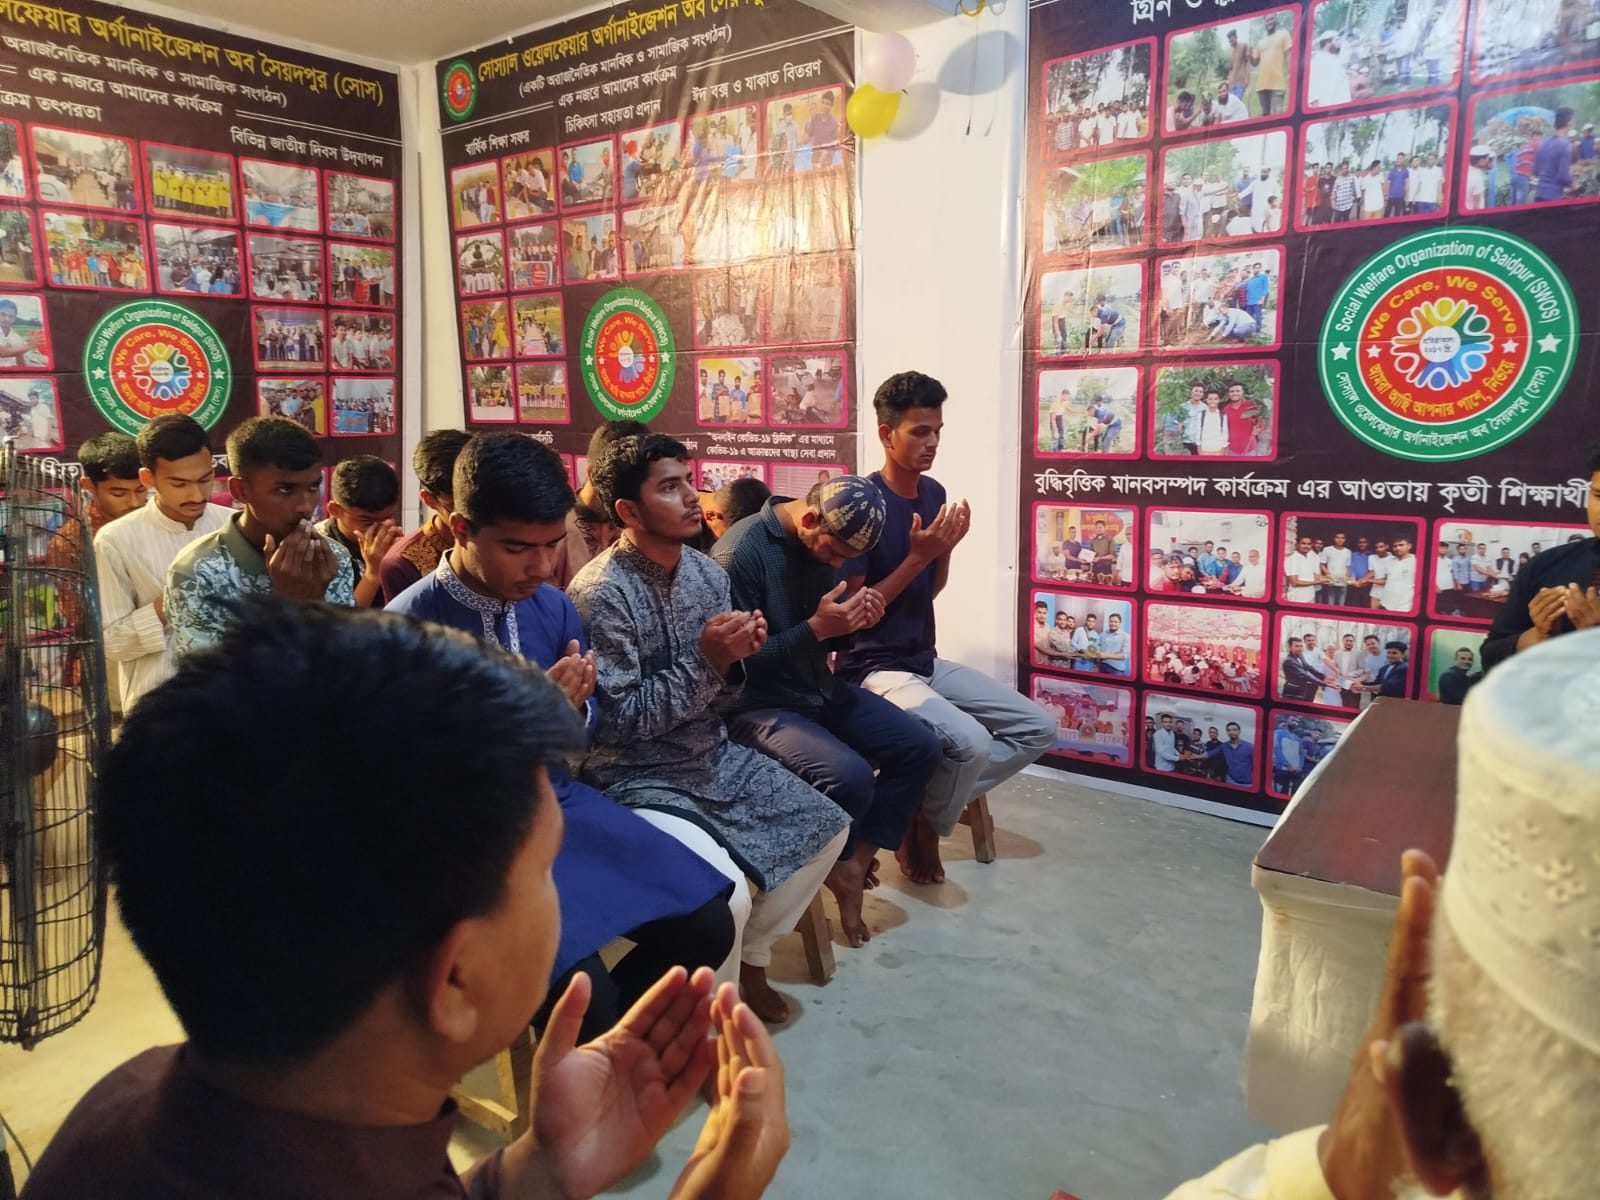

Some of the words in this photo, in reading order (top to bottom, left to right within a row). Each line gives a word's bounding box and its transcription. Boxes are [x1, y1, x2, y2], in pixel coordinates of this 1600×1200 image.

[521, 30, 589, 67] ওয়েলফেয়ার
[591, 3, 678, 47] অর্গানাইজেশন
[546, 63, 599, 87] অরাজনৈতিক
[600, 51, 634, 73] মানবিক
[636, 51, 645, 63] ও
[647, 37, 689, 60] সামাজিক
[691, 23, 733, 47] সংগঠন)
[1, 35, 101, 66] অরাজনৈতিক
[104, 56, 159, 79] মানবিক
[162, 70, 176, 83] ও
[180, 71, 238, 95] সামাজিক
[239, 85, 288, 109] সংগঠন)
[86, 16, 220, 67] অর্গানাইজেশন
[224, 48, 255, 74] অব
[257, 50, 329, 94] সৈয়দপুর
[333, 72, 384, 107] (সোস)
[732, 79, 742, 93] ও
[745, 69, 781, 90] যাকাত
[782, 58, 823, 84] বিতরণ
[28, 66, 58, 85] এক
[61, 71, 105, 94] নজরে
[108, 81, 169, 106] আমাদের
[172, 93, 223, 116] কার্যক্রম
[35, 96, 103, 122] তৎপরতা
[557, 93, 575, 109] এক
[575, 86, 600, 103] নজরে
[601, 75, 639, 98] আমাদের
[641, 64, 678, 87] কার্যক্রম
[564, 111, 599, 134] চিকিৎসা
[599, 104, 635, 126] সহায়তা
[635, 98, 662, 117] প্রদান
[230, 125, 267, 150] বিভিন্ন
[269, 135, 306, 155] জাতীয়
[309, 141, 339, 161] দিবস
[488, 131, 510, 152] শিক্ষা
[509, 129, 531, 146] সফর
[1335, 297, 1362, 332] Social
[1353, 264, 1396, 299] Welfare
[1394, 240, 1474, 269] Organization
[1475, 244, 1494, 259] of
[1490, 246, 1535, 282] Saidpur
[1524, 277, 1561, 323] (SWOS)
[1368, 312, 1390, 338] We
[1389, 281, 1440, 308] Care,
[1446, 275, 1478, 291] We
[1481, 286, 1517, 334] Serve
[115, 349, 128, 366] We
[126, 329, 156, 346] Care,
[157, 329, 178, 341] We
[179, 333, 203, 368] Serve
[598, 336, 608, 353] We
[624, 316, 637, 326] We
[1413, 401, 1455, 417] আপনার
[1033, 468, 1107, 499] বুদ্ধিবৃত্তিক
[1111, 473, 1208, 496] মানবসম্পদ
[1213, 471, 1292, 498] কার্যক্রম
[1297, 480, 1333, 500] এর
[1338, 478, 1432, 503] আওতায়
[1438, 475, 1492, 513] কৃতী
